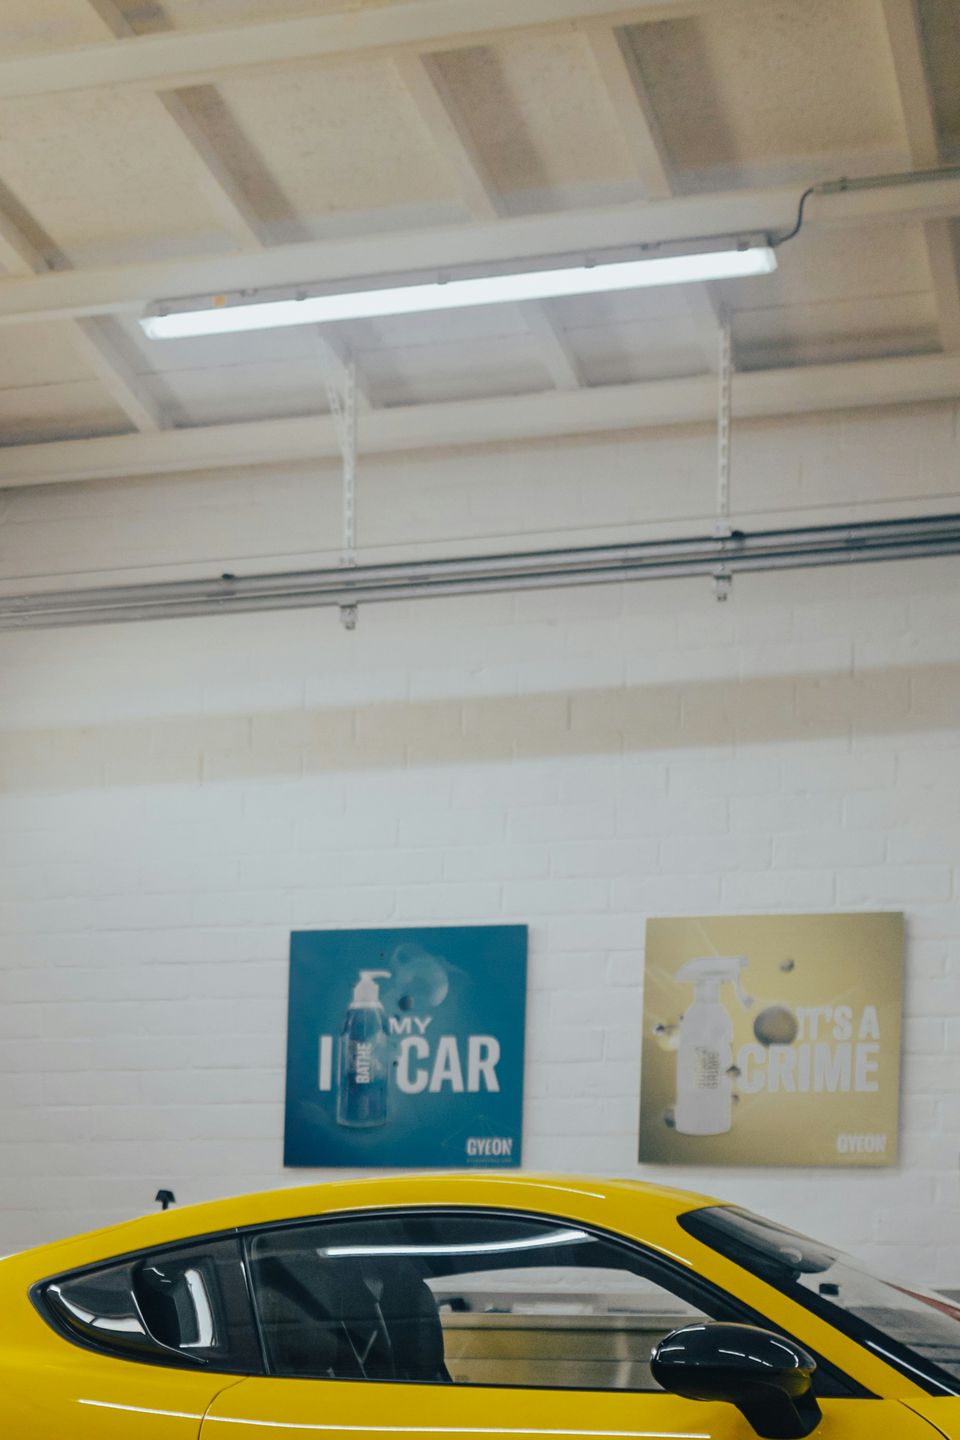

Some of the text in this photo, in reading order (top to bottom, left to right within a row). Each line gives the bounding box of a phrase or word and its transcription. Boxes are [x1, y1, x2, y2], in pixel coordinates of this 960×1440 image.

[389, 1016, 432, 1034] MY
[796, 1004, 880, 1041] IT'S A
[319, 1036, 501, 1094] I CAR
[355, 1042, 373, 1084] BATHE
[736, 1041, 880, 1093] CRIME
[466, 1137, 513, 1156] GYEON
